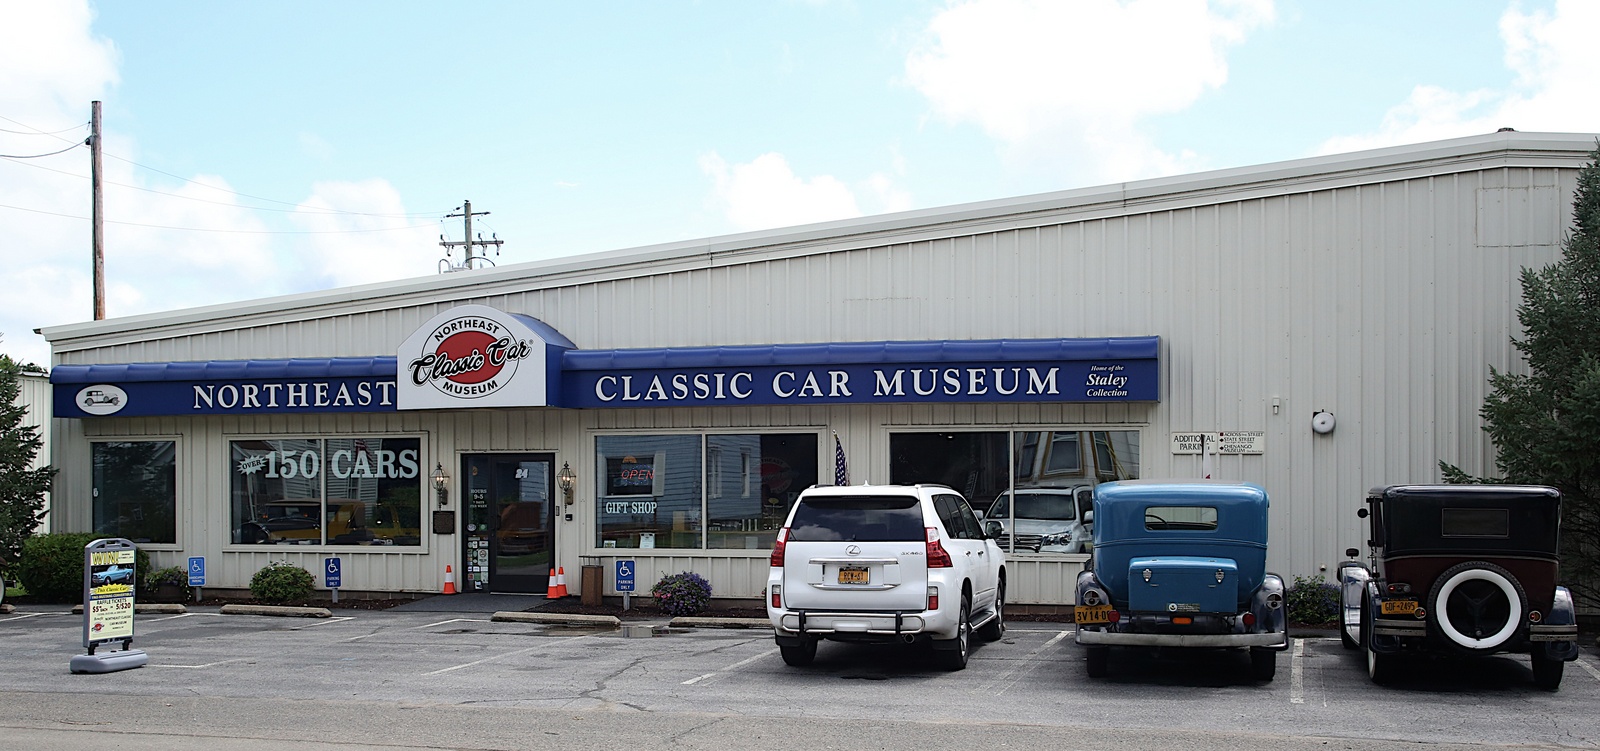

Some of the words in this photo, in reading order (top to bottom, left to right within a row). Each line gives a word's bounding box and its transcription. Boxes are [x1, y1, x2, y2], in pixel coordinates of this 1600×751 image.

[434, 319, 500, 342] NORTHEAST
[409, 349, 484, 385] Classic
[487, 338, 531, 365] Car
[442, 380, 499, 395] MUSEUM
[595, 372, 753, 401] CLASSIC
[772, 370, 853, 398] CAR
[873, 367, 1060, 396] MUSEUM
[1086, 373, 1128, 389] Staley
[193, 381, 396, 409] NORTHEAST
[1086, 388, 1128, 397] Collection
[1173, 435, 1216, 443] ADDITIOAL
[242, 459, 262, 470] OVER
[265, 450, 319, 479] 150
[331, 449, 419, 479] CARS
[515, 468, 529, 479] 24
[621, 469, 655, 480] OPEN
[605, 502, 629, 514] GIFT
[631, 501, 658, 514] SHOP
[92, 551, 119, 565] WIN!
